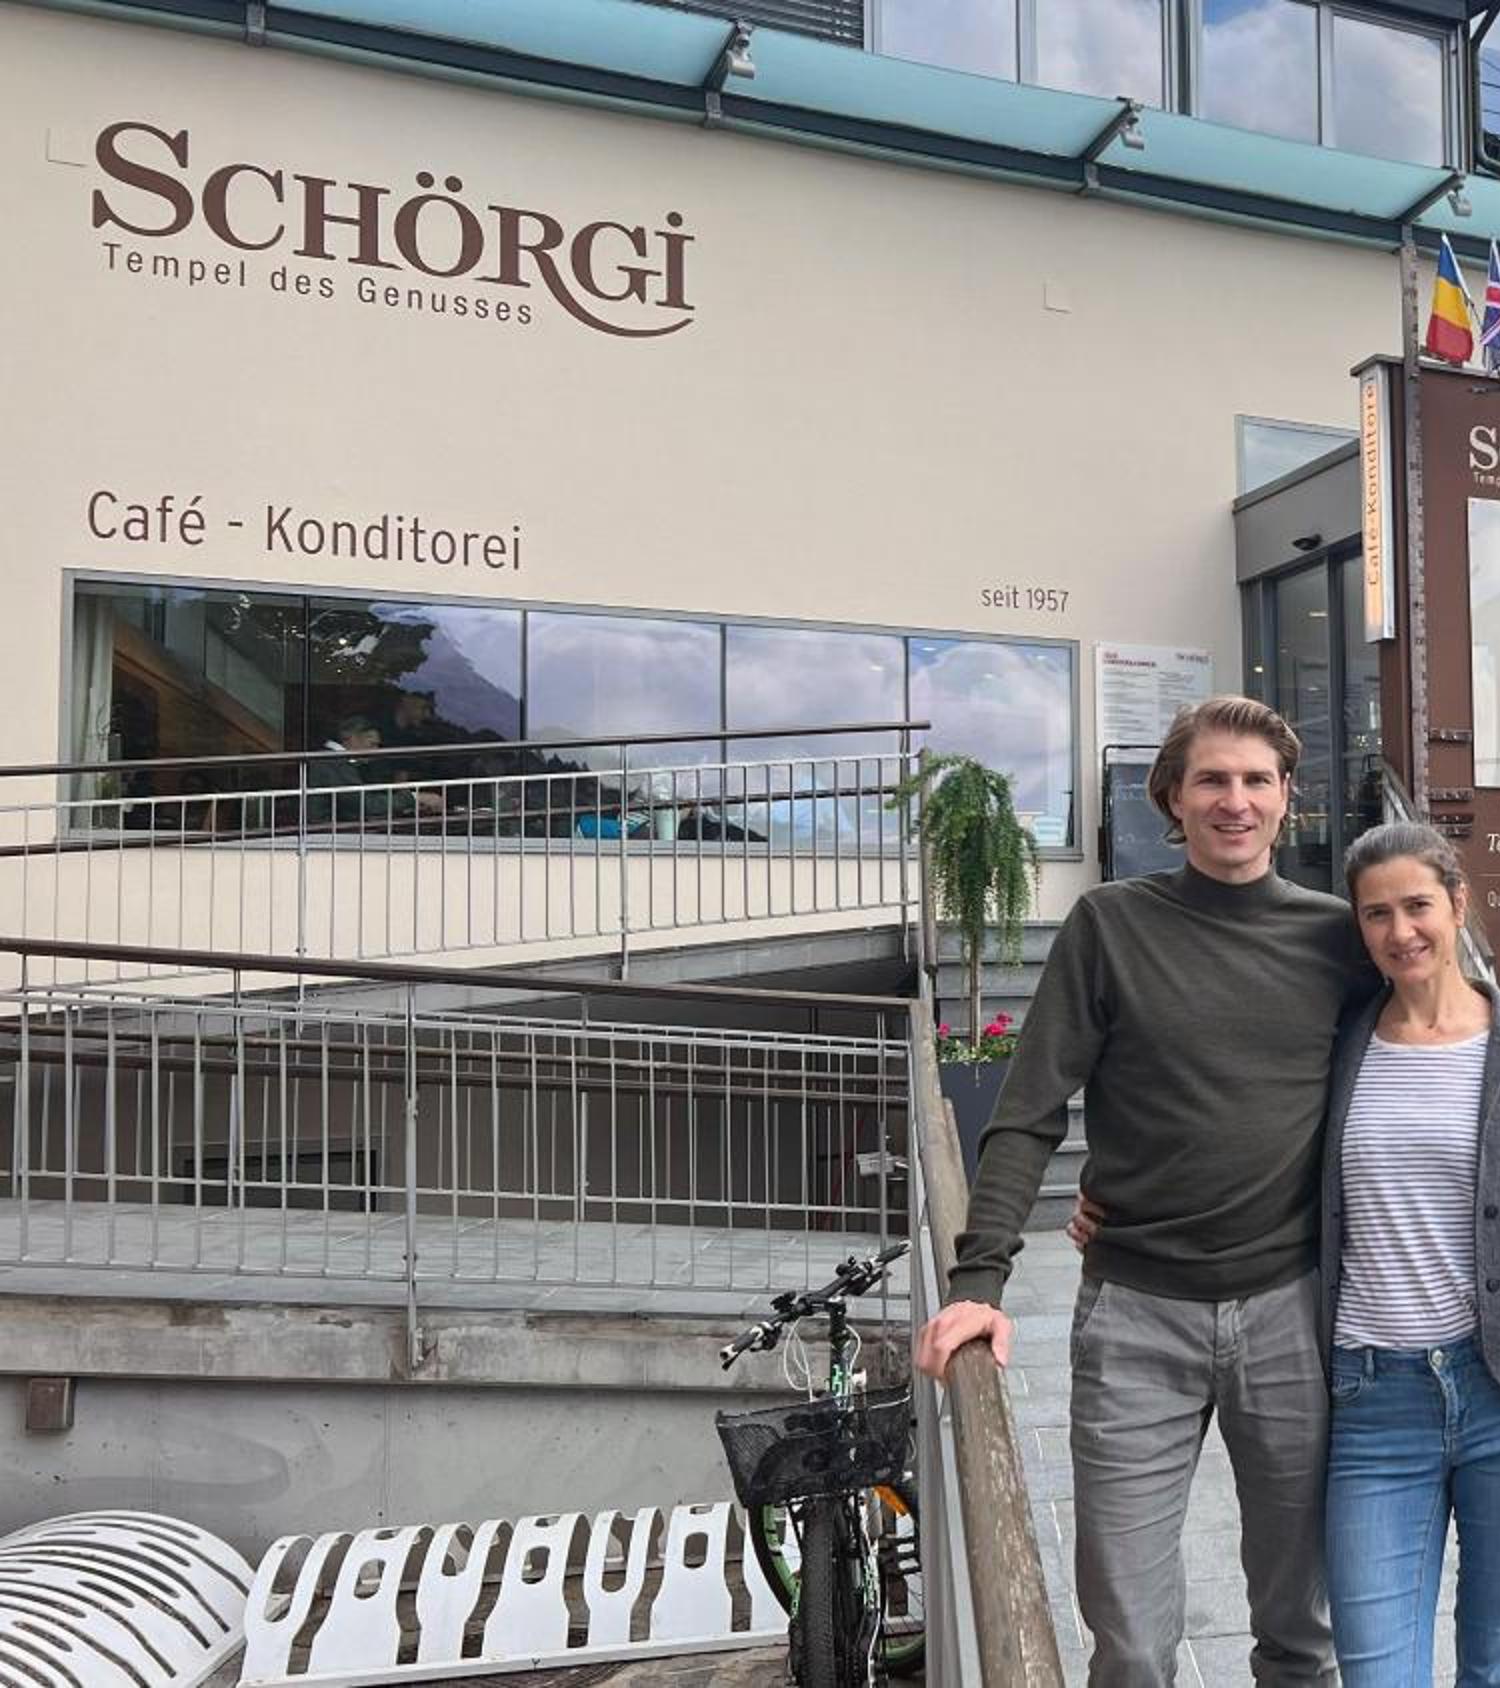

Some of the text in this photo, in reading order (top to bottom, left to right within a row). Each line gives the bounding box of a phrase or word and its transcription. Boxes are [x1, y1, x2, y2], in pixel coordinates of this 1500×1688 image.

[102, 242, 534, 325] Tempel des Genusses
[87, 490, 207, 546] Café
[266, 506, 522, 571] Konditorei
[981, 586, 1070, 613] seit 1957
